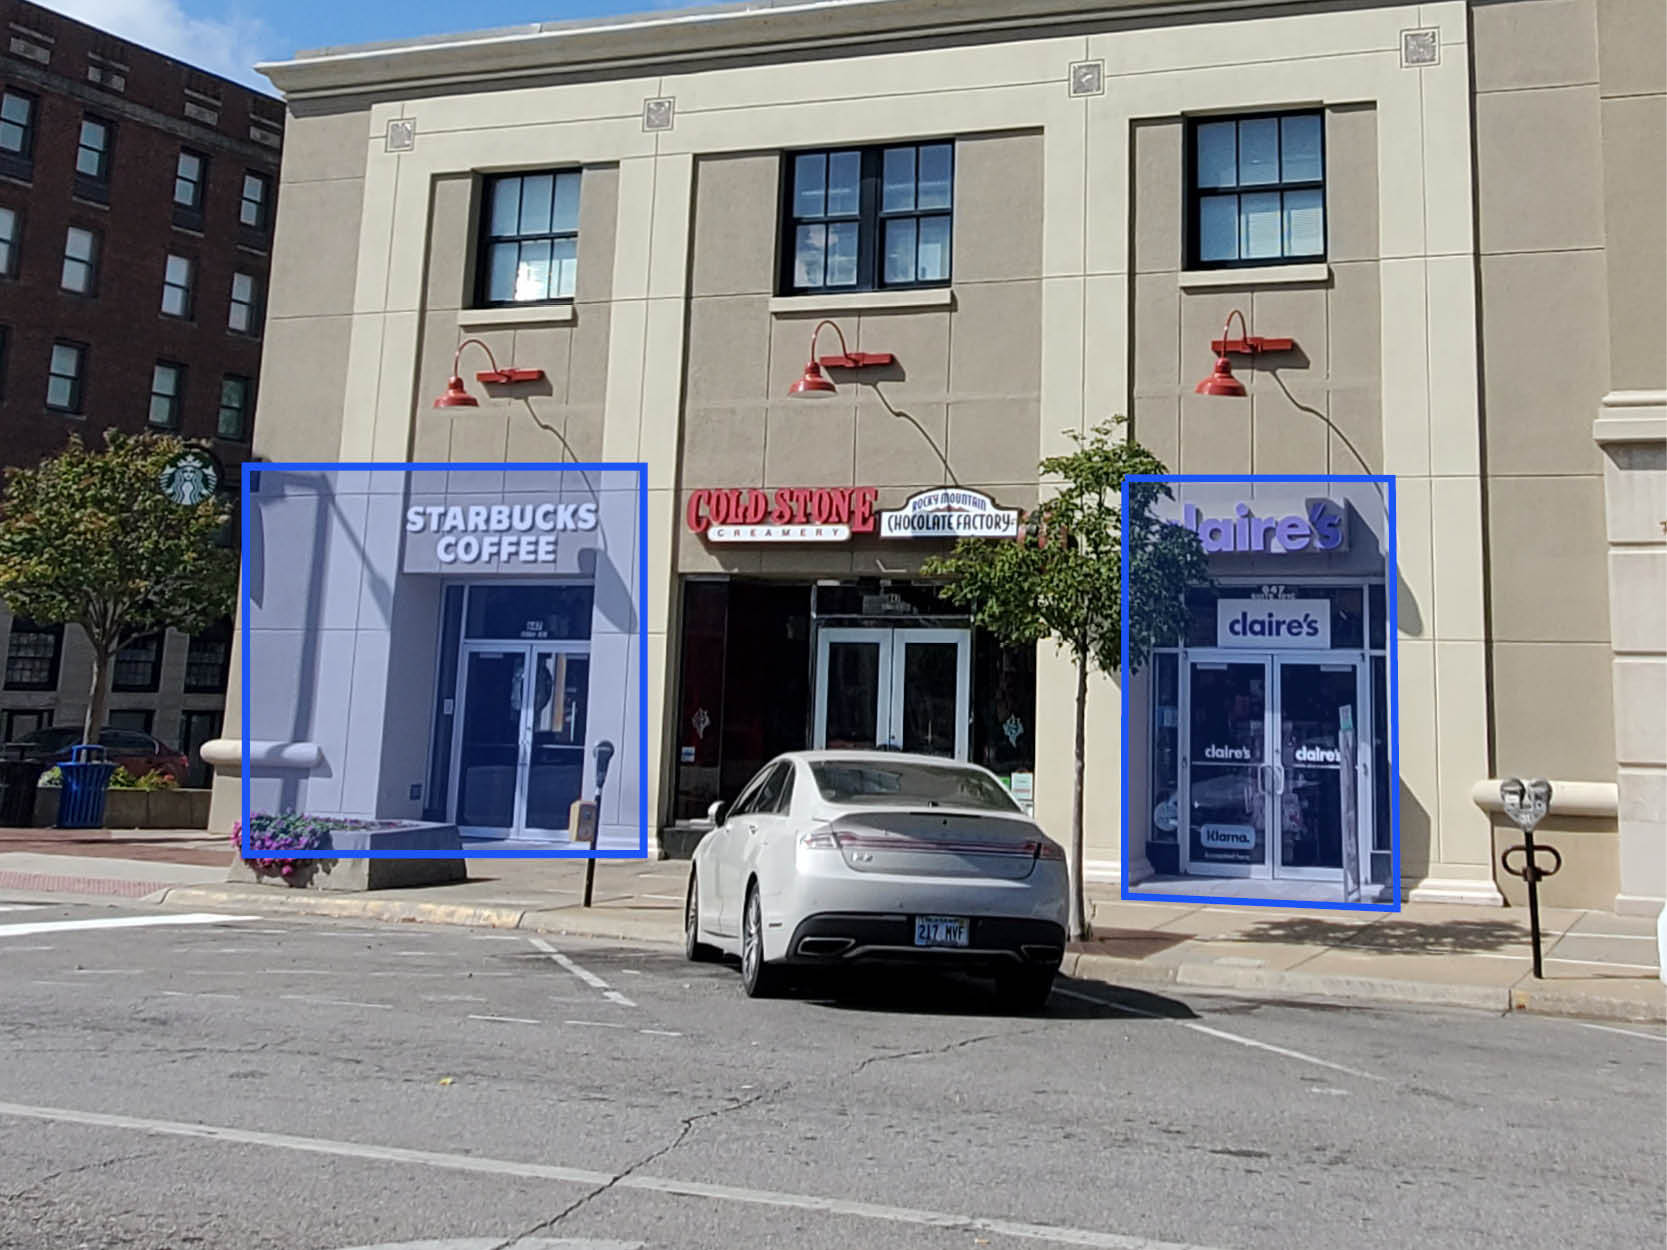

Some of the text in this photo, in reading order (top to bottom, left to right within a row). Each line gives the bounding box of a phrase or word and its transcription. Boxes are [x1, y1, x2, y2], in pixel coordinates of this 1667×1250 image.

[687, 487, 878, 533] COLD STONE
[912, 492, 986, 511] ROCKY MOUNTAIN
[406, 503, 598, 532] STARBUCKS
[888, 512, 955, 533] CHOCOLATE
[955, 513, 1010, 533] FACTORY
[1167, 502, 1343, 551] laire's
[716, 527, 841, 538] CREAMERY
[436, 535, 557, 564] COFFEE
[1228, 611, 1319, 637] claire's
[1204, 744, 1251, 760] claire's
